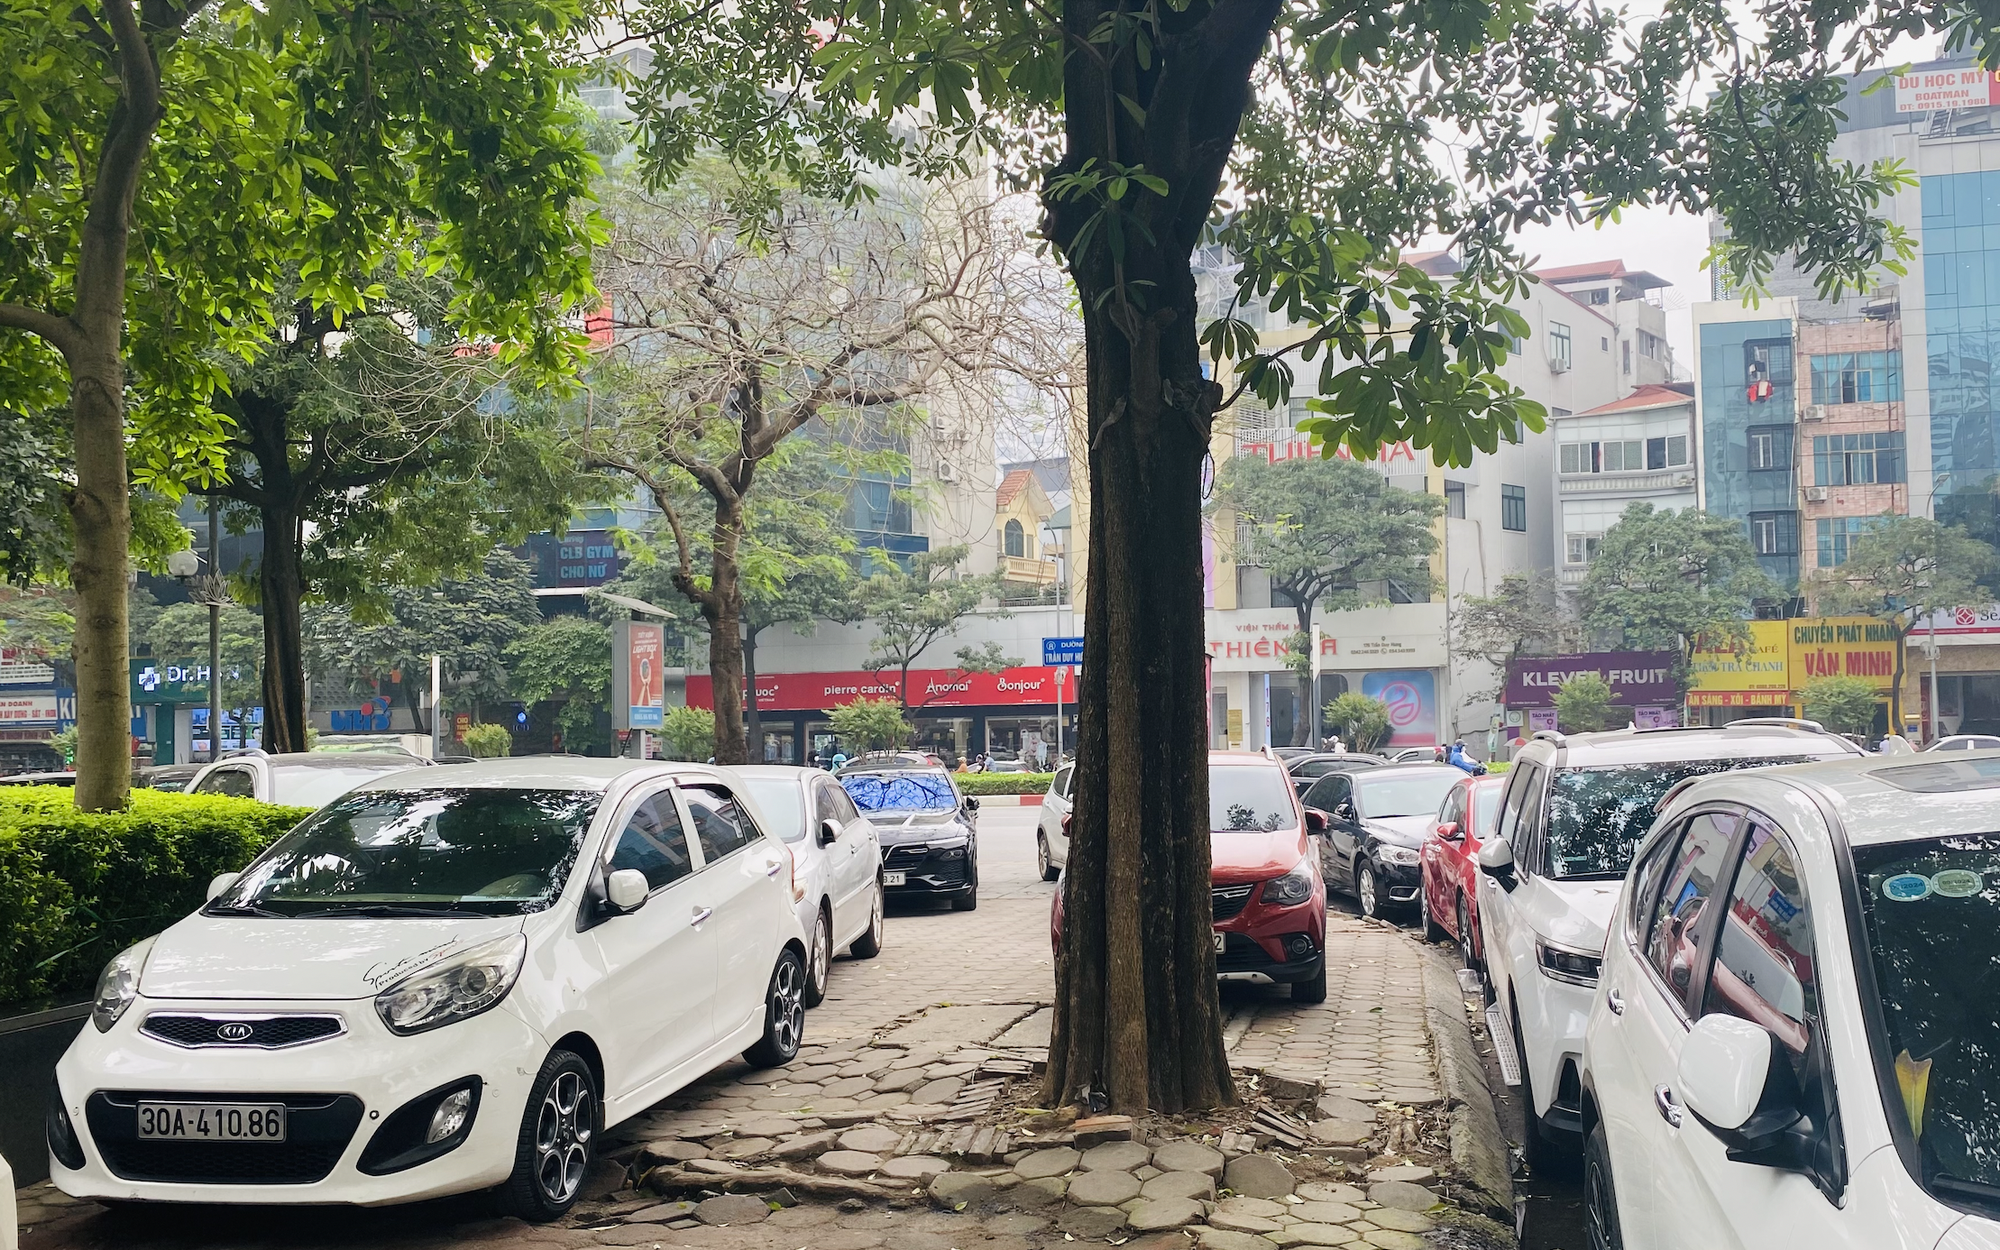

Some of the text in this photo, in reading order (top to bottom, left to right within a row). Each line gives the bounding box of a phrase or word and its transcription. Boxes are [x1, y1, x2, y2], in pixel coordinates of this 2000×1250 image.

[1899, 76, 1919, 89] DU
[1925, 73, 1956, 89] HỌC
[1915, 89, 1969, 101] BOATMAN
[560, 545, 614, 559] CLB GYM
[560, 562, 607, 578] CHO NỮ
[1980, 609, 2000, 621] Se
[1794, 619, 1833, 644] CHUYỂN
[1836, 621, 1862, 643] PHÁT
[1756, 644, 1779, 653] AFÉ
[1045, 651, 1061, 663] TRẦN
[1062, 652, 1074, 662] DUY
[1804, 647, 1892, 677] VĂN MINH
[1609, 668, 1668, 685] FRUIT
[824, 685, 857, 696] pierre
[860, 683, 896, 694] cardin
[997, 678, 1041, 694] Bonjour
[1702, 693, 1723, 705] SÁNG
[1750, 693, 1772, 705] BÁNH
[222, 1025, 247, 1038] KIA
[141, 1107, 281, 1138] 30A-410.86
